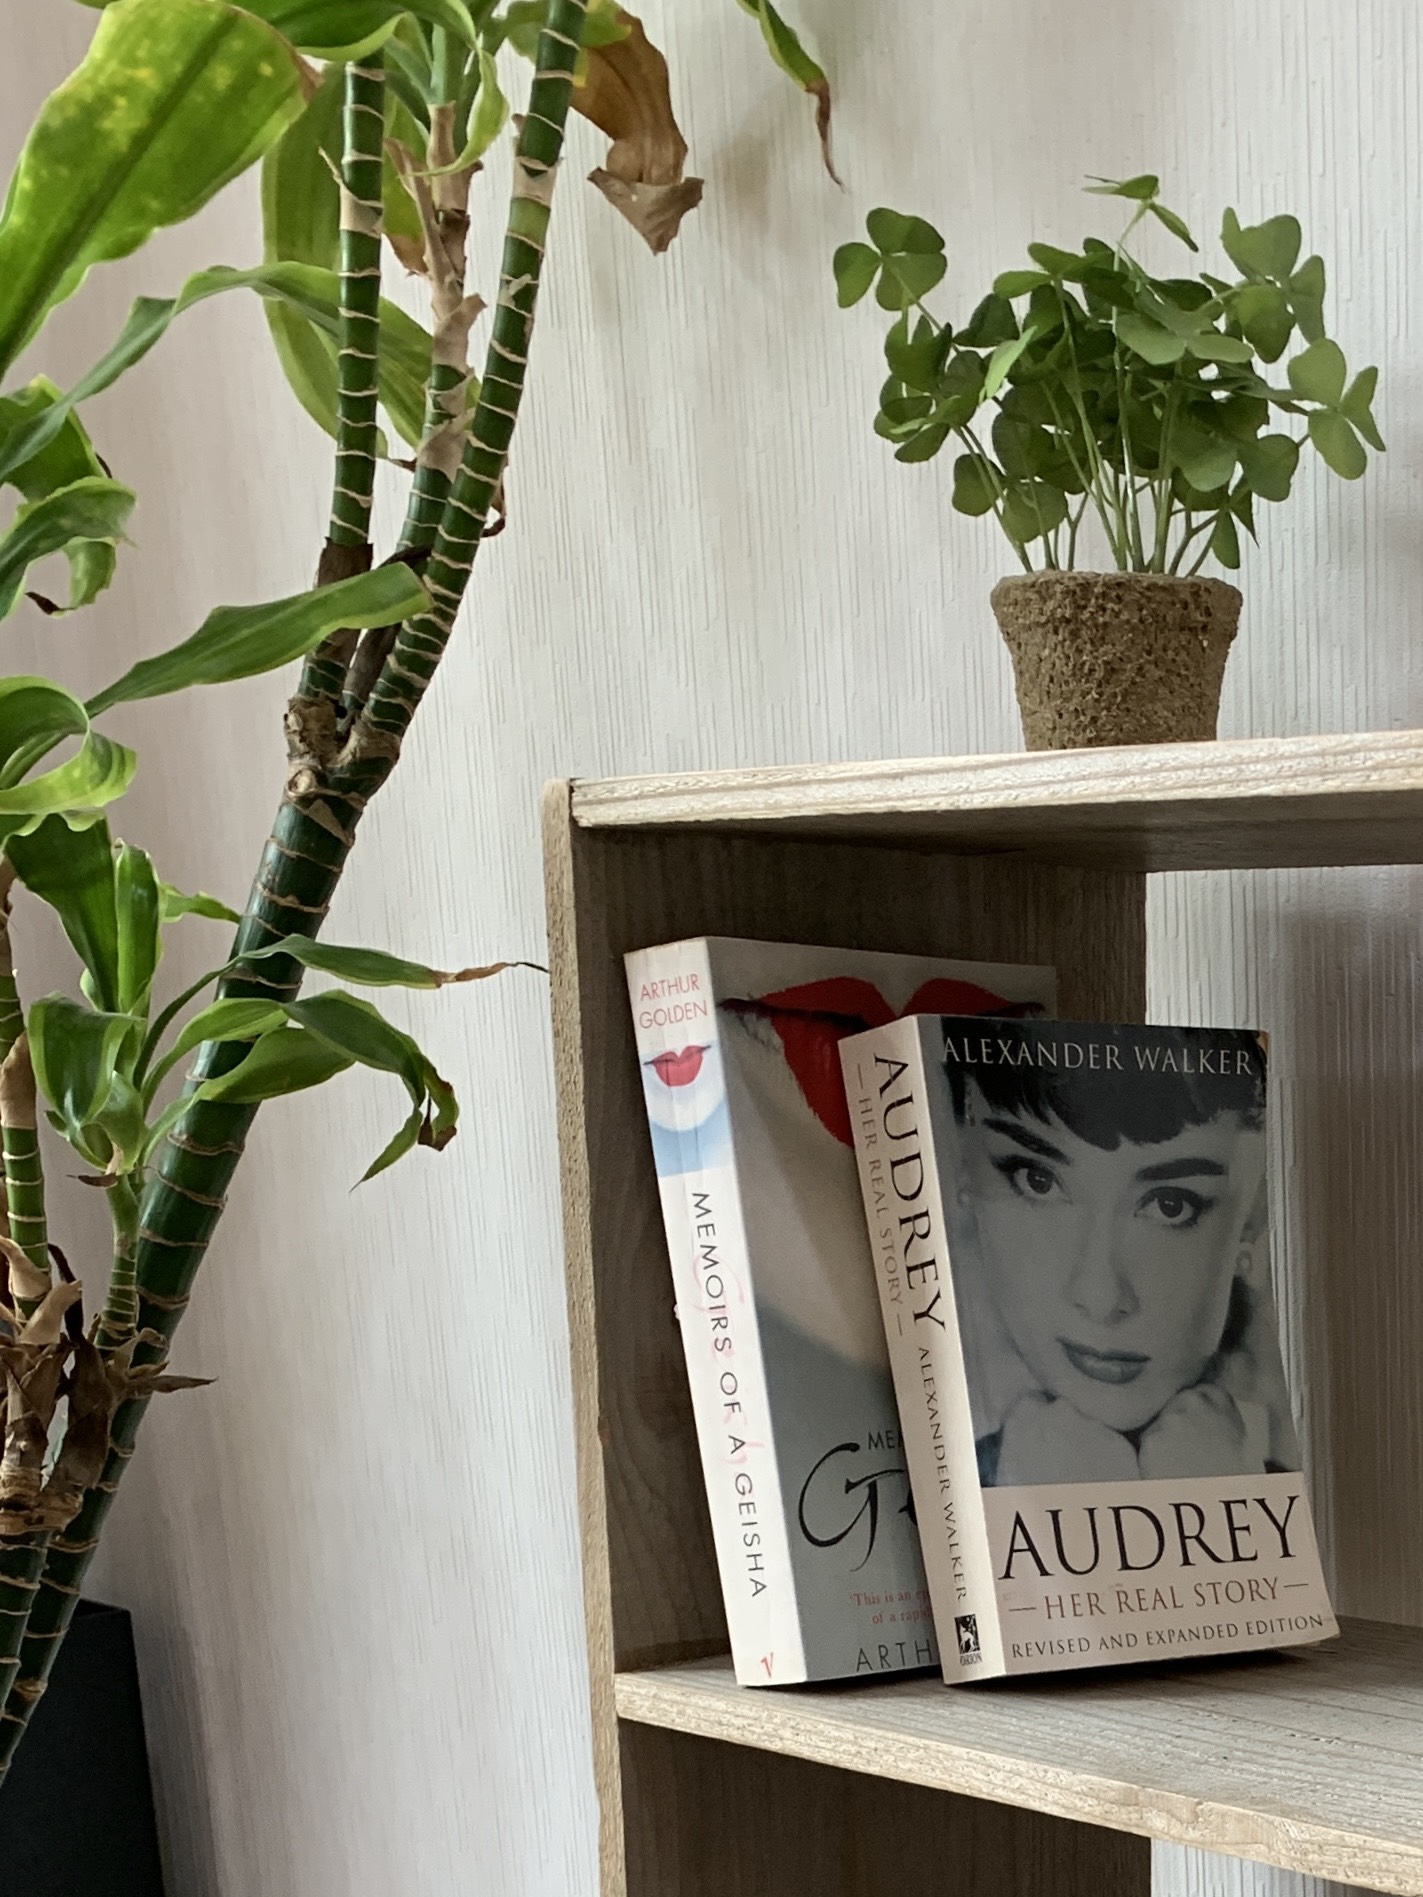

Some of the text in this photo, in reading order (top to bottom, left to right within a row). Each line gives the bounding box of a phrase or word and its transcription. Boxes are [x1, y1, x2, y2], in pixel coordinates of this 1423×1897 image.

[640, 973, 700, 1001] ARTHUR
[639, 1000, 708, 1029] GOLDEN
[942, 1037, 1252, 1075] ALEXANDER WALKER
[858, 1097, 903, 1310] HER REAL STORY
[874, 1052, 945, 1330] AUDREY
[692, 1192, 767, 1597] MEMOIRS OF A GEISHA
[868, 1430, 903, 1450] ME
[918, 1346, 967, 1602] ALEXANDER WALKER
[997, 1495, 1300, 1580] AUDREY
[1044, 1576, 1279, 1620] HER REAL STORY
[1011, 1613, 1324, 1659] REVISED AND EXPANDED EDITION
